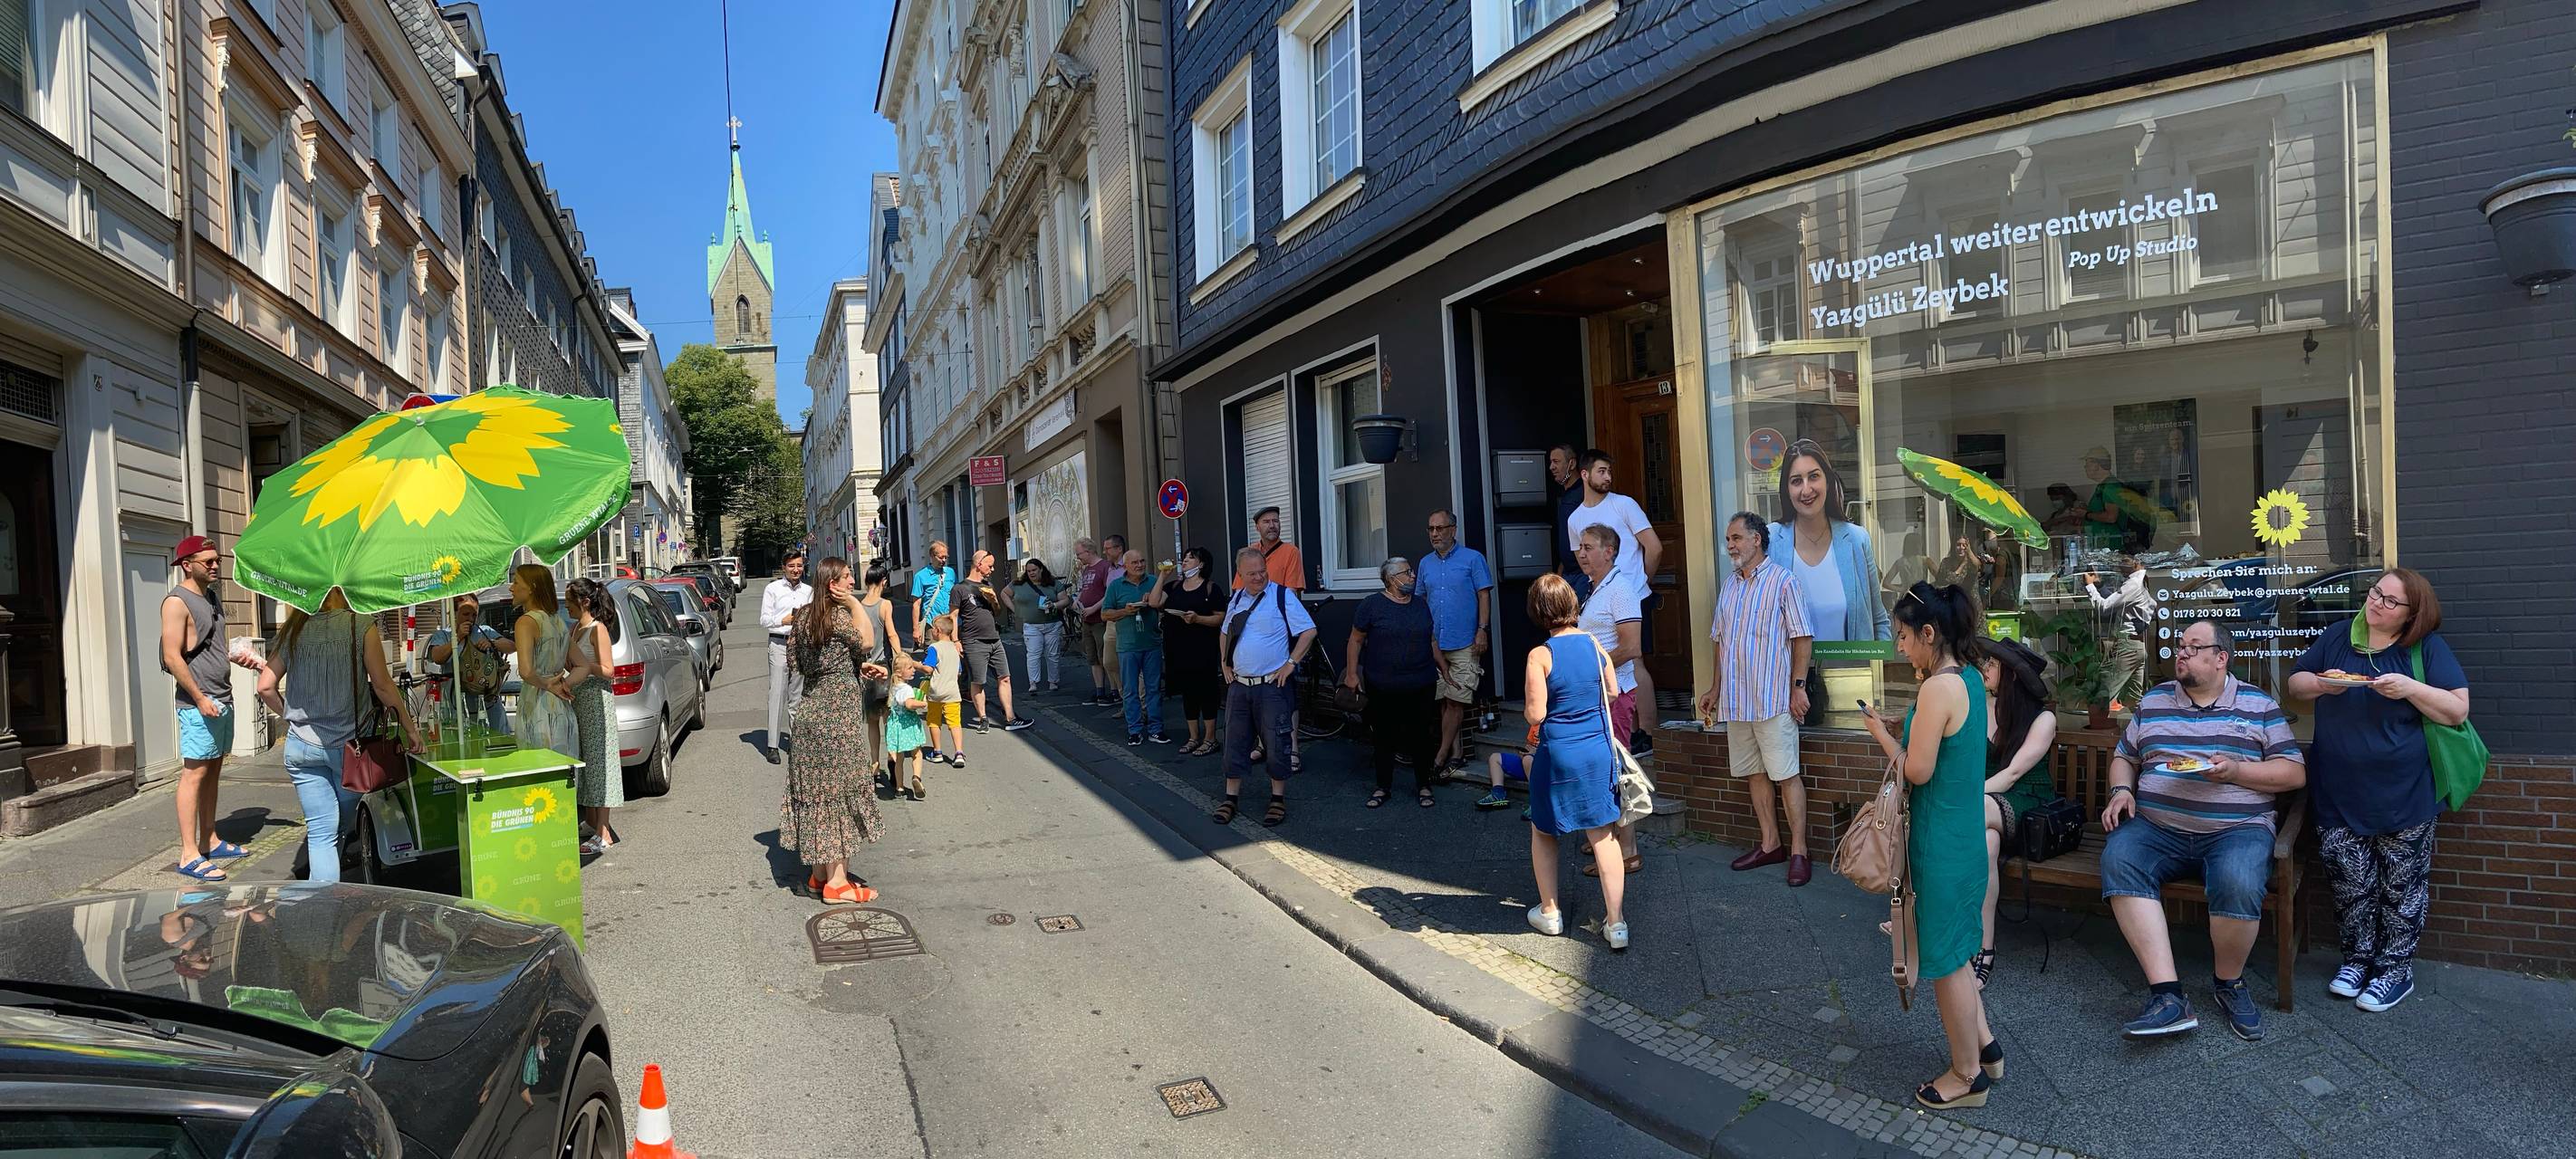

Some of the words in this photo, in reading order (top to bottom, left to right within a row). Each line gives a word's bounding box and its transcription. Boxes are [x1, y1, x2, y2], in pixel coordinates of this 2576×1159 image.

[1809, 234, 1945, 284] Wuppertal
[2069, 251, 2101, 270] Pop
[2106, 244, 2130, 265] Up
[2135, 234, 2198, 258] Studio
[1811, 292, 1908, 329] Yazgülü
[1912, 273, 2009, 314] Zeybek
[994, 458, 999, 466] S
[2171, 566, 2233, 580] Sprechen
[2235, 565, 2255, 577] Sie
[2258, 564, 2293, 577] mich
[2296, 565, 2317, 575] an:
[2172, 585, 2350, 599] Yazgulu.Zeybek@gruene-wtal.de
[2174, 608, 2196, 618] 0178
[2197, 608, 2209, 618] 20
[2210, 608, 2224, 618] 30
[2225, 608, 2241, 618] 821
[492, 808, 524, 819] BÜNDNIS
[524, 806, 534, 814] 90
[491, 819, 503, 829] DIE
[505, 815, 534, 826] GRÜNEN
